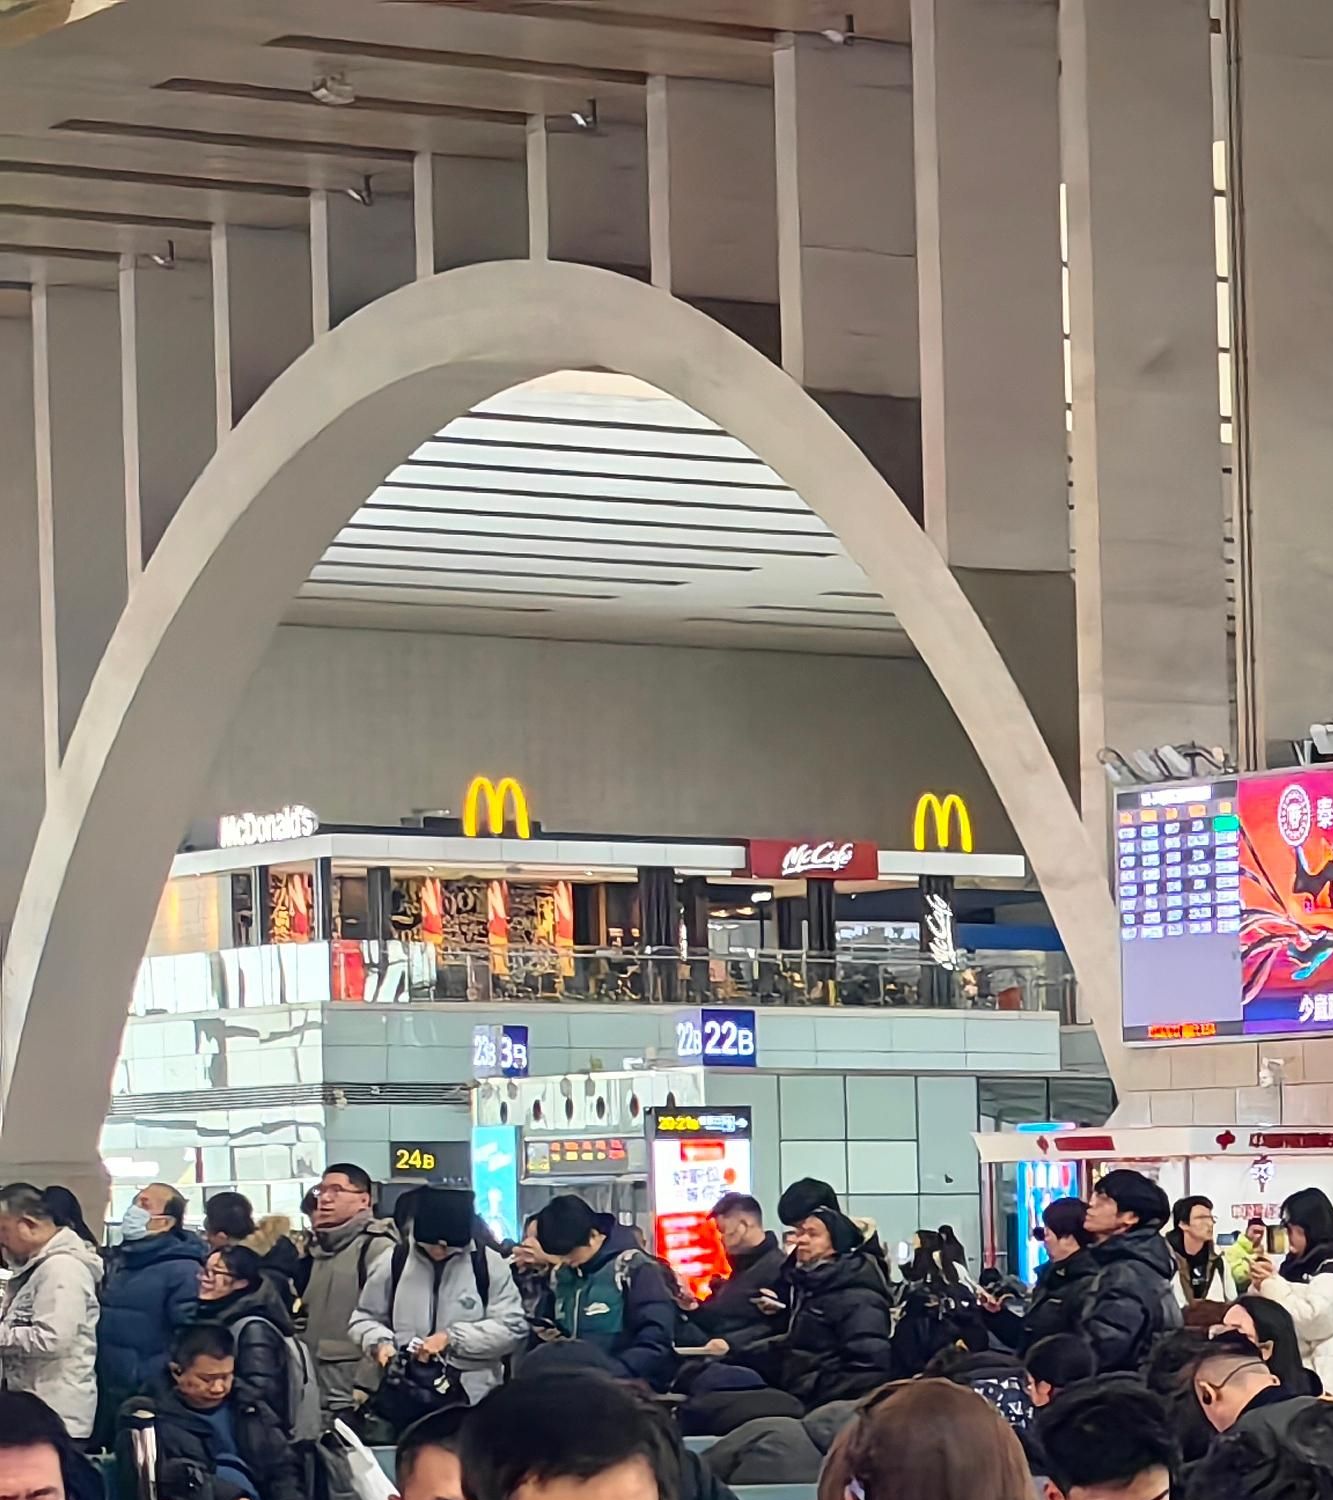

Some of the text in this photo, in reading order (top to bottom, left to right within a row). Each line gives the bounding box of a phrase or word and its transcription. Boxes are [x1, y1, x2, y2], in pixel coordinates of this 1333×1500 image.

[218, 804, 318, 848] McDonald's
[500, 1036, 527, 1068] 3B
[704, 1021, 755, 1056] 22B
[395, 1149, 435, 1169] 24B
